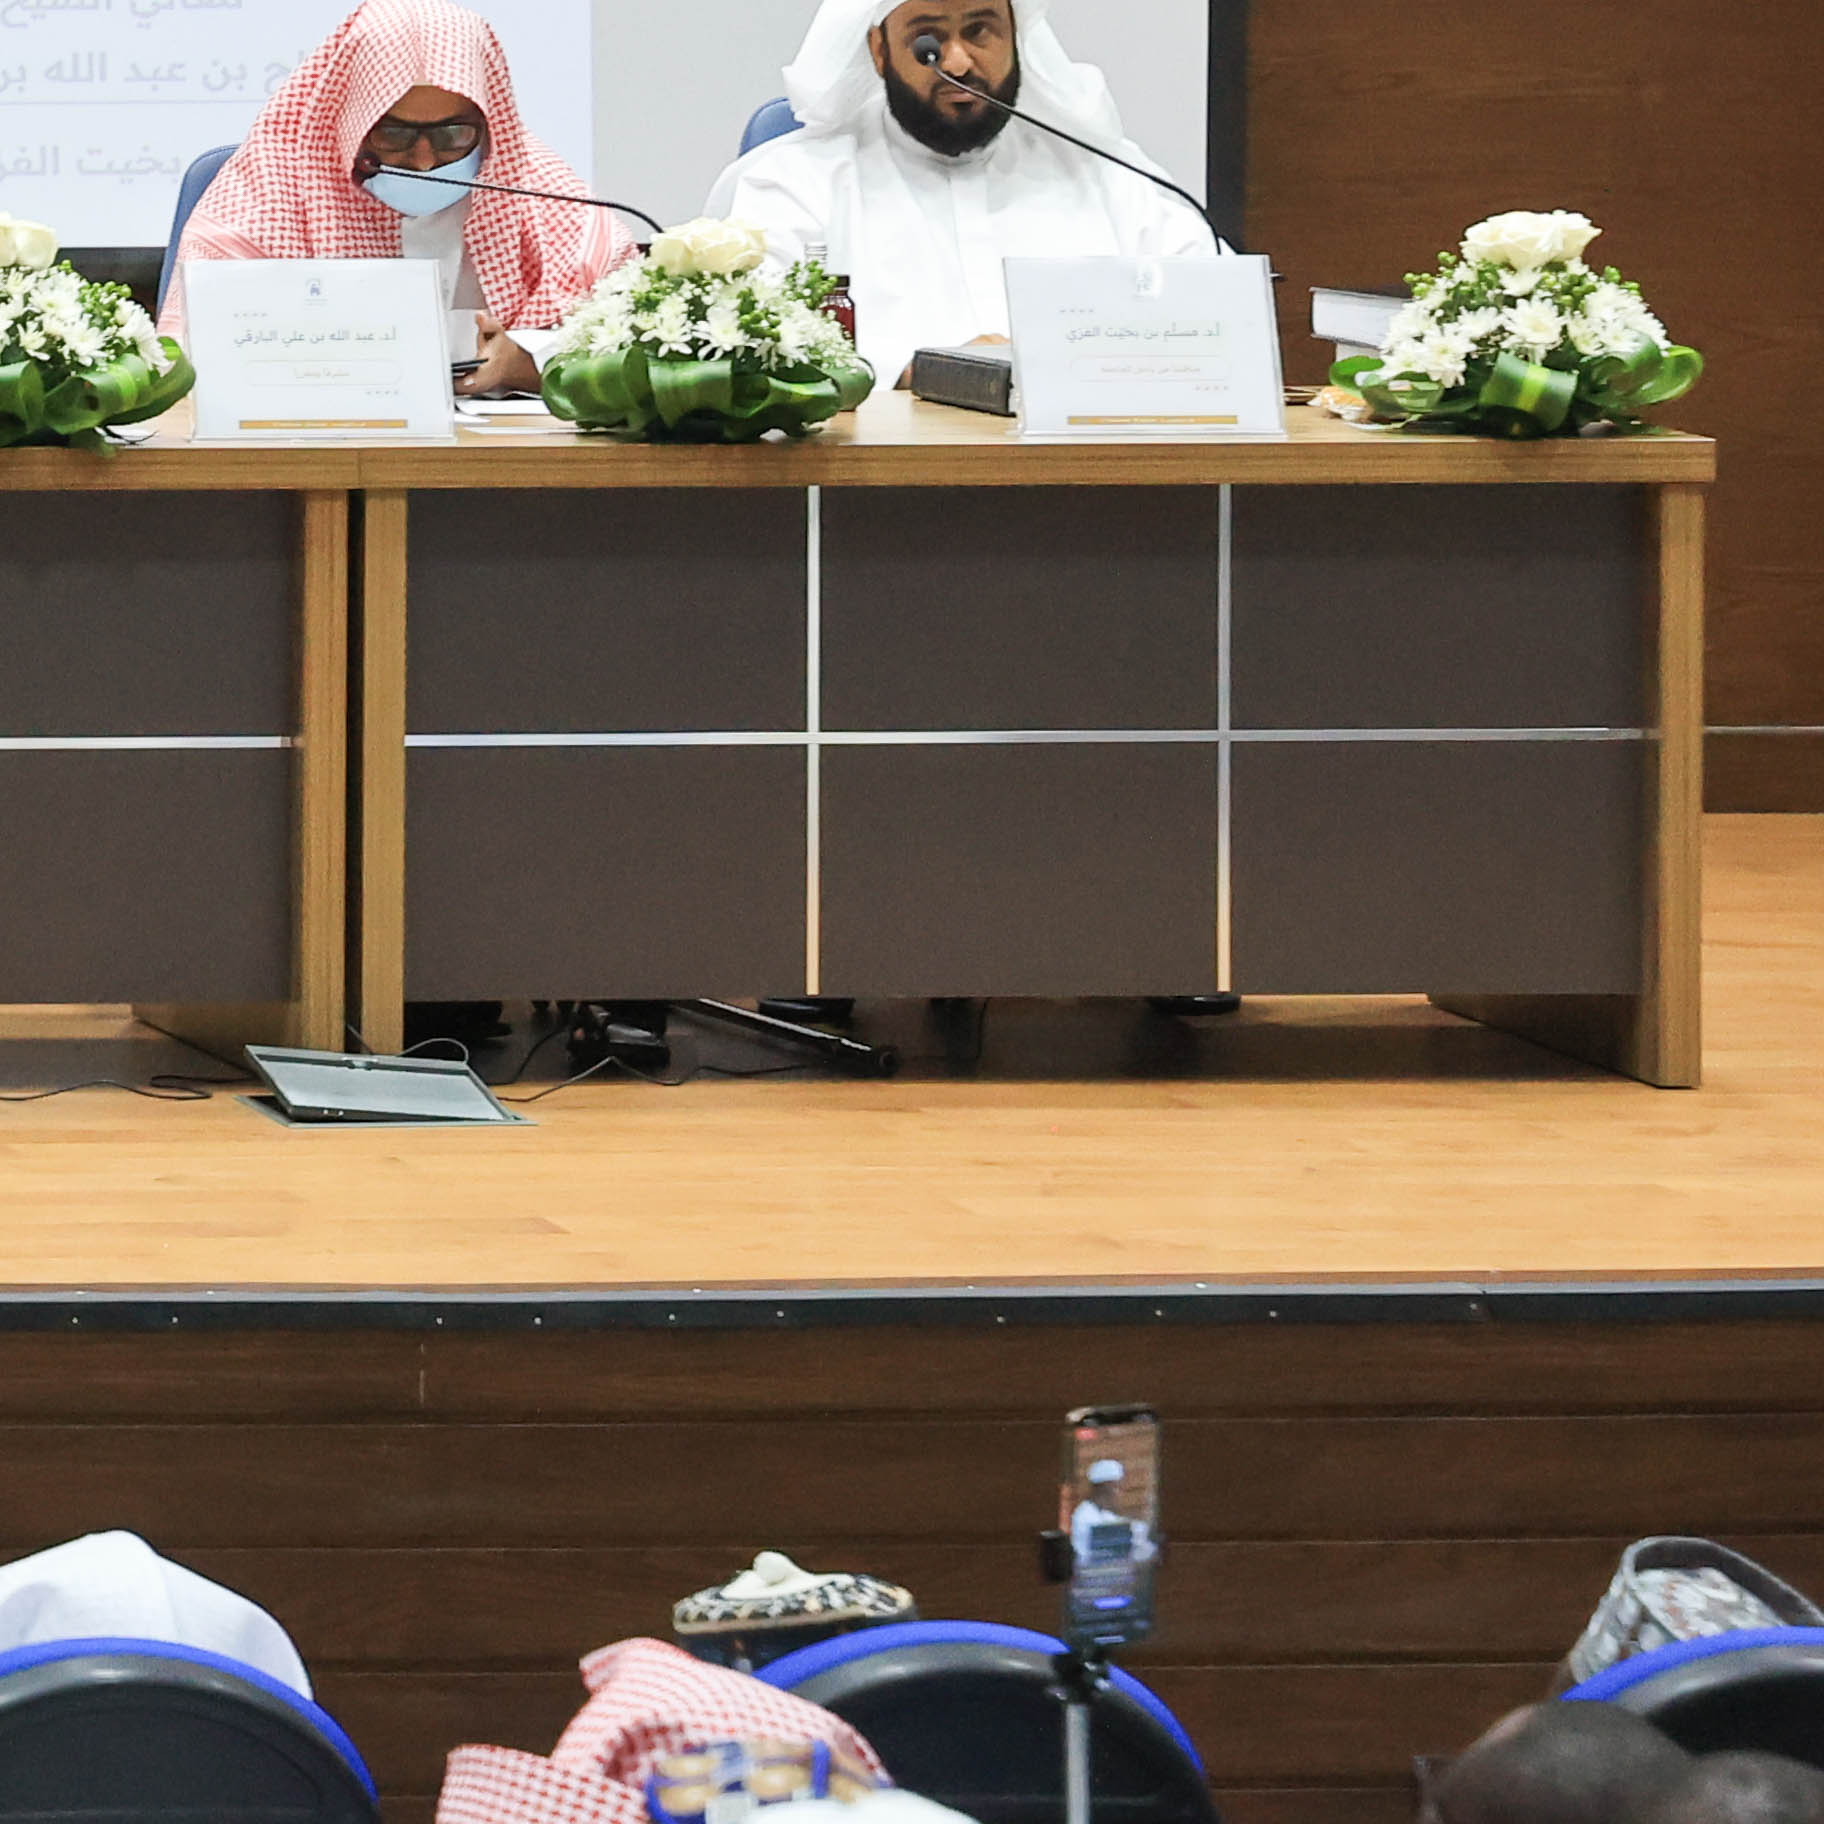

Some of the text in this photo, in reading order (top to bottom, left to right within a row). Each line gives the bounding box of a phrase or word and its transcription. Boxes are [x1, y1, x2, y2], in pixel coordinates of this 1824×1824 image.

[43, 50, 108, 83] الله
[123, 62, 187, 92] عبد
[201, 59, 248, 93] بن
